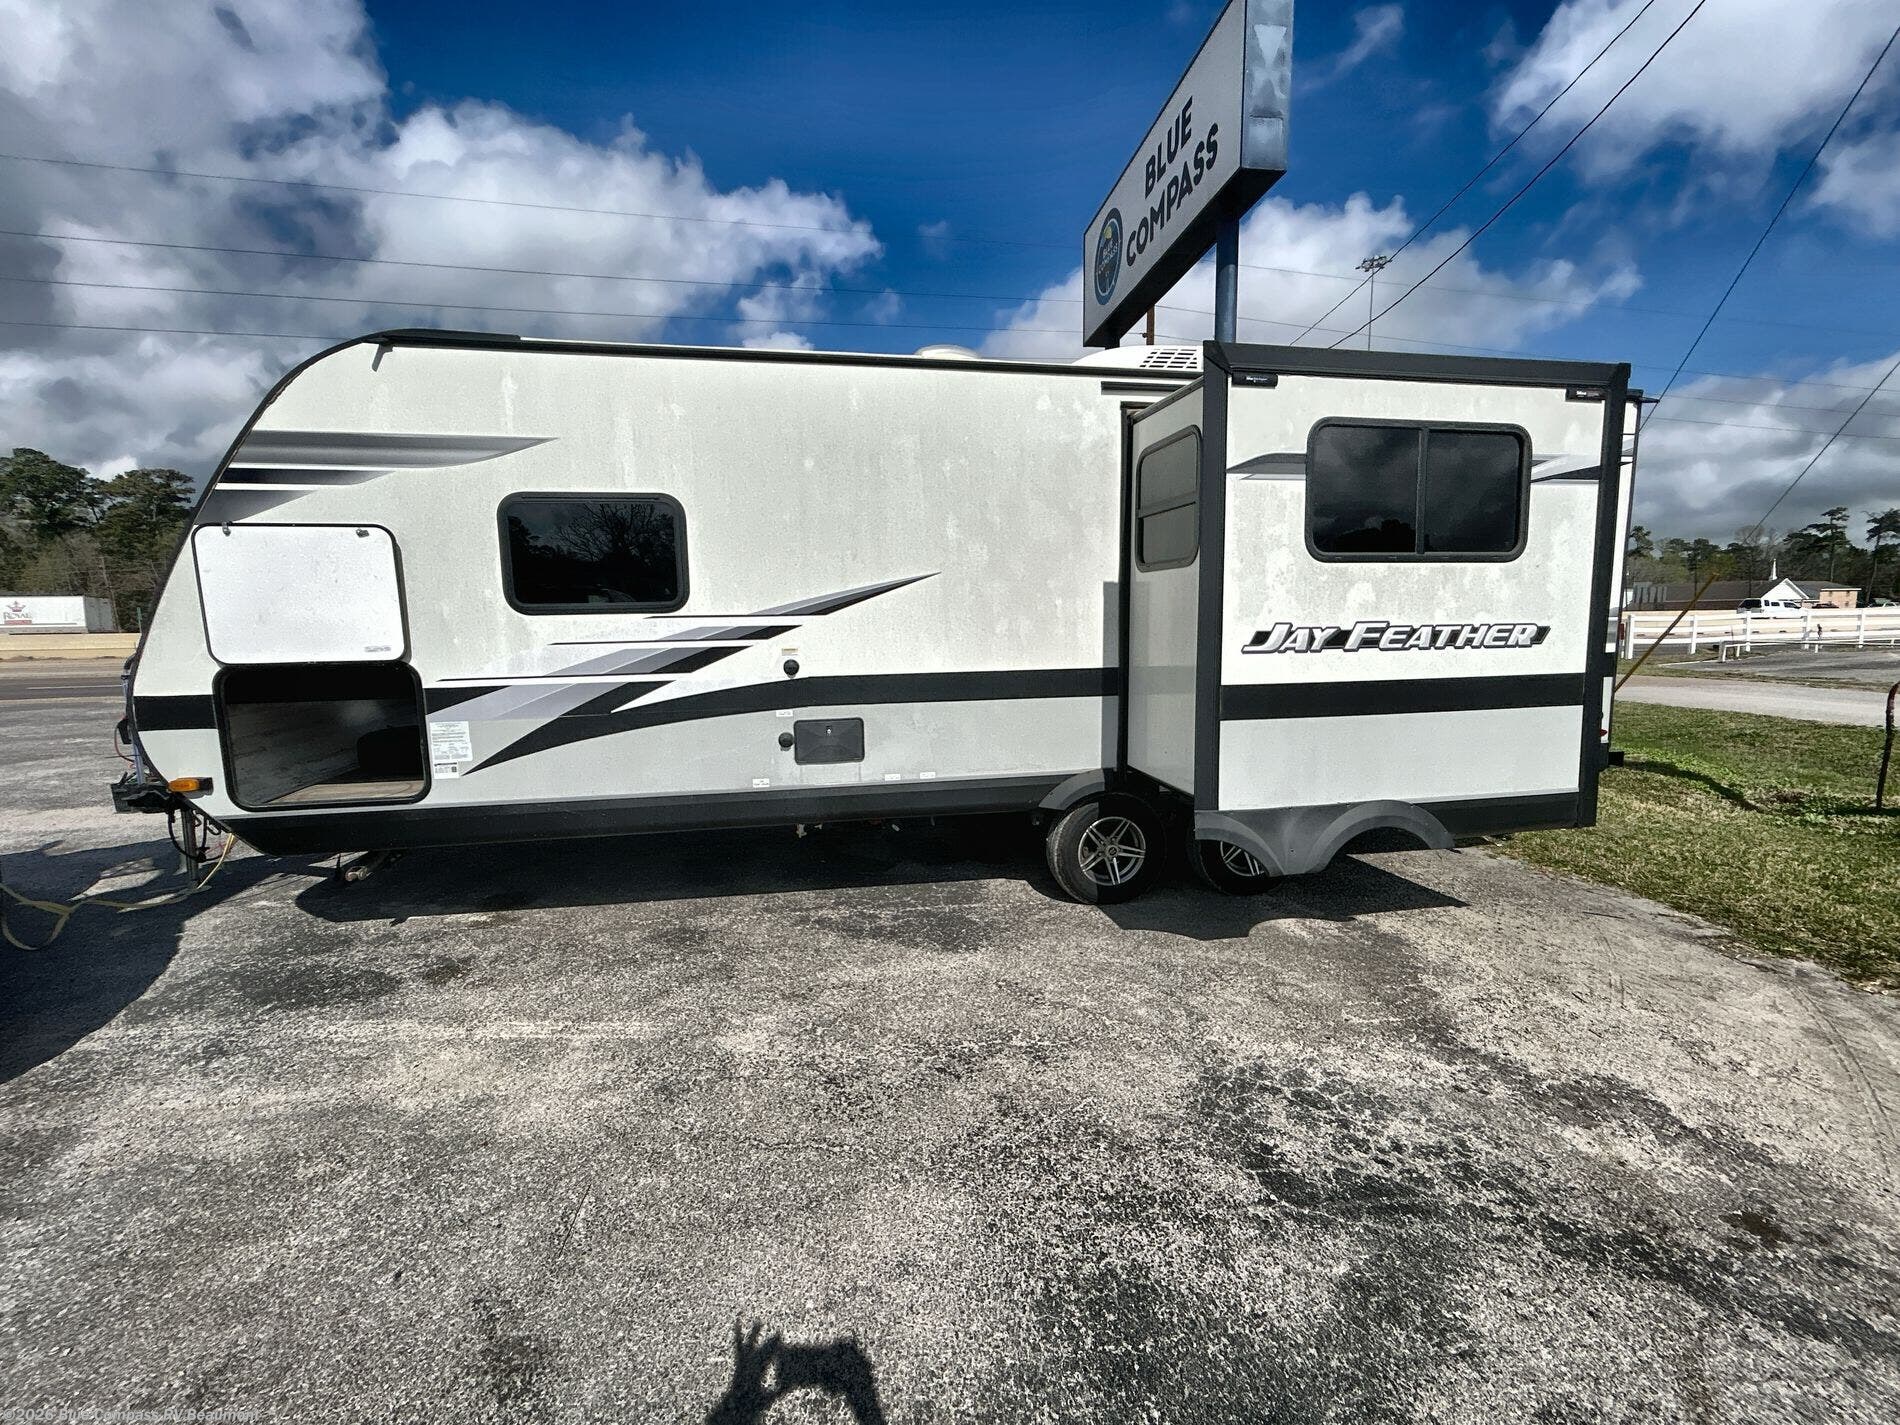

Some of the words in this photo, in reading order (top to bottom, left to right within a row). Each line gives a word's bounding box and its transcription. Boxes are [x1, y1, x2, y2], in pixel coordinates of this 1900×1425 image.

[1127, 123, 1218, 267] COMPASS
[1145, 96, 1192, 199] BLUE
[1241, 622, 1340, 654] JAY
[1344, 621, 1540, 652] FEATHER
